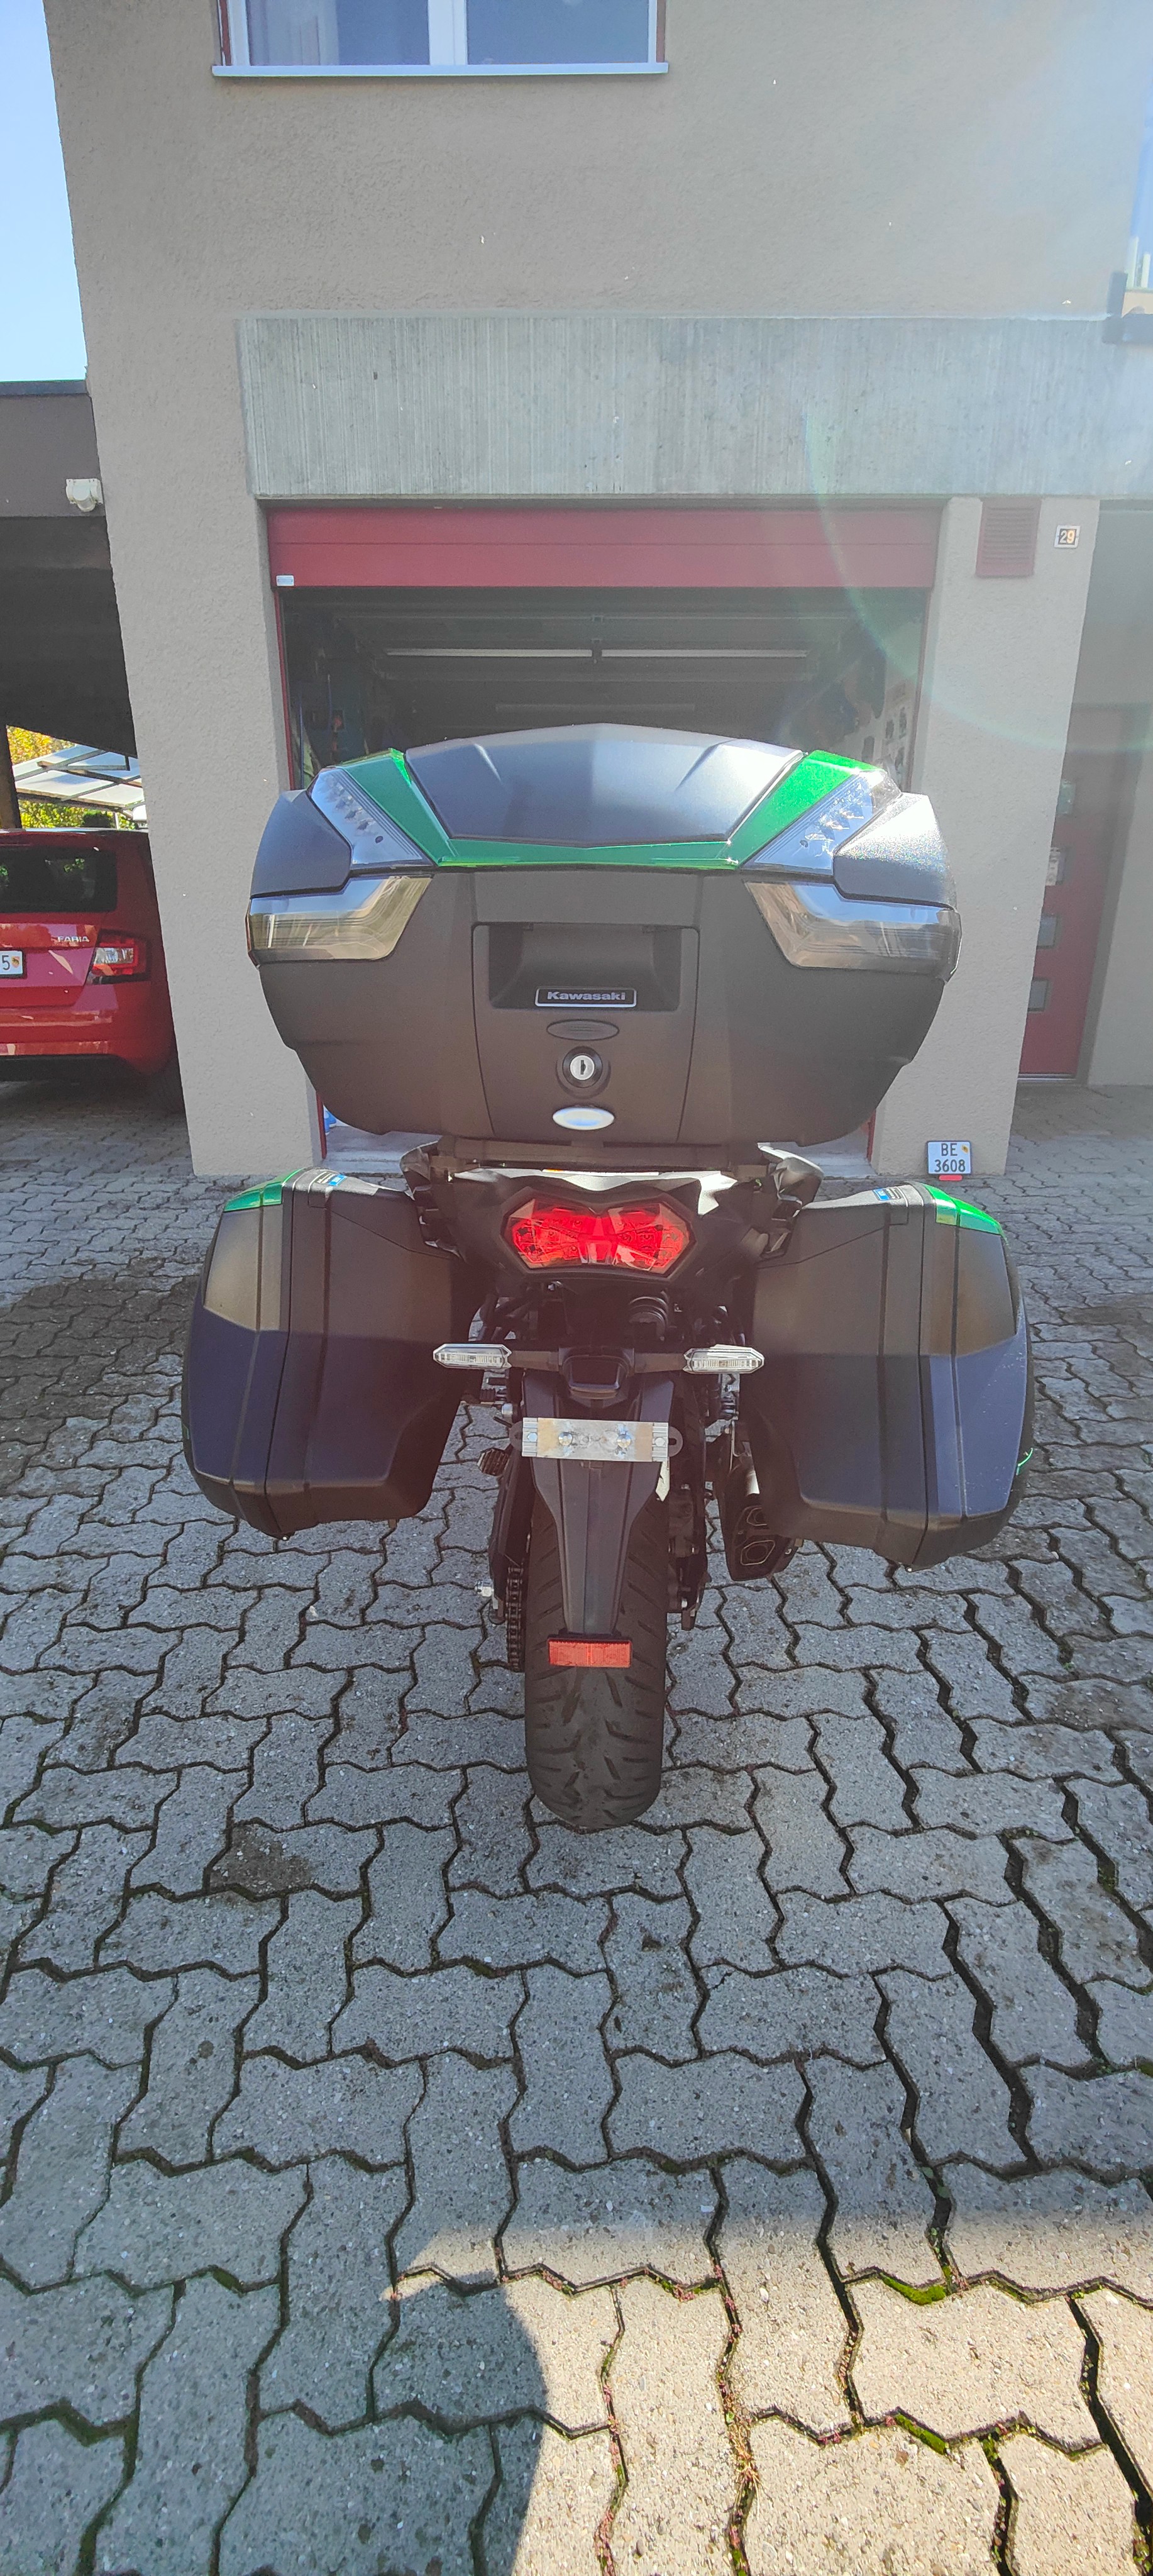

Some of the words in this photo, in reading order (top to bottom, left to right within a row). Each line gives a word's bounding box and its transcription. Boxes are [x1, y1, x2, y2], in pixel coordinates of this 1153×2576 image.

[1059, 530, 1074, 544] 29
[547, 991, 626, 1001] Kawasaki
[941, 1143, 957, 1157] BE
[934, 1158, 966, 1172] 3608
